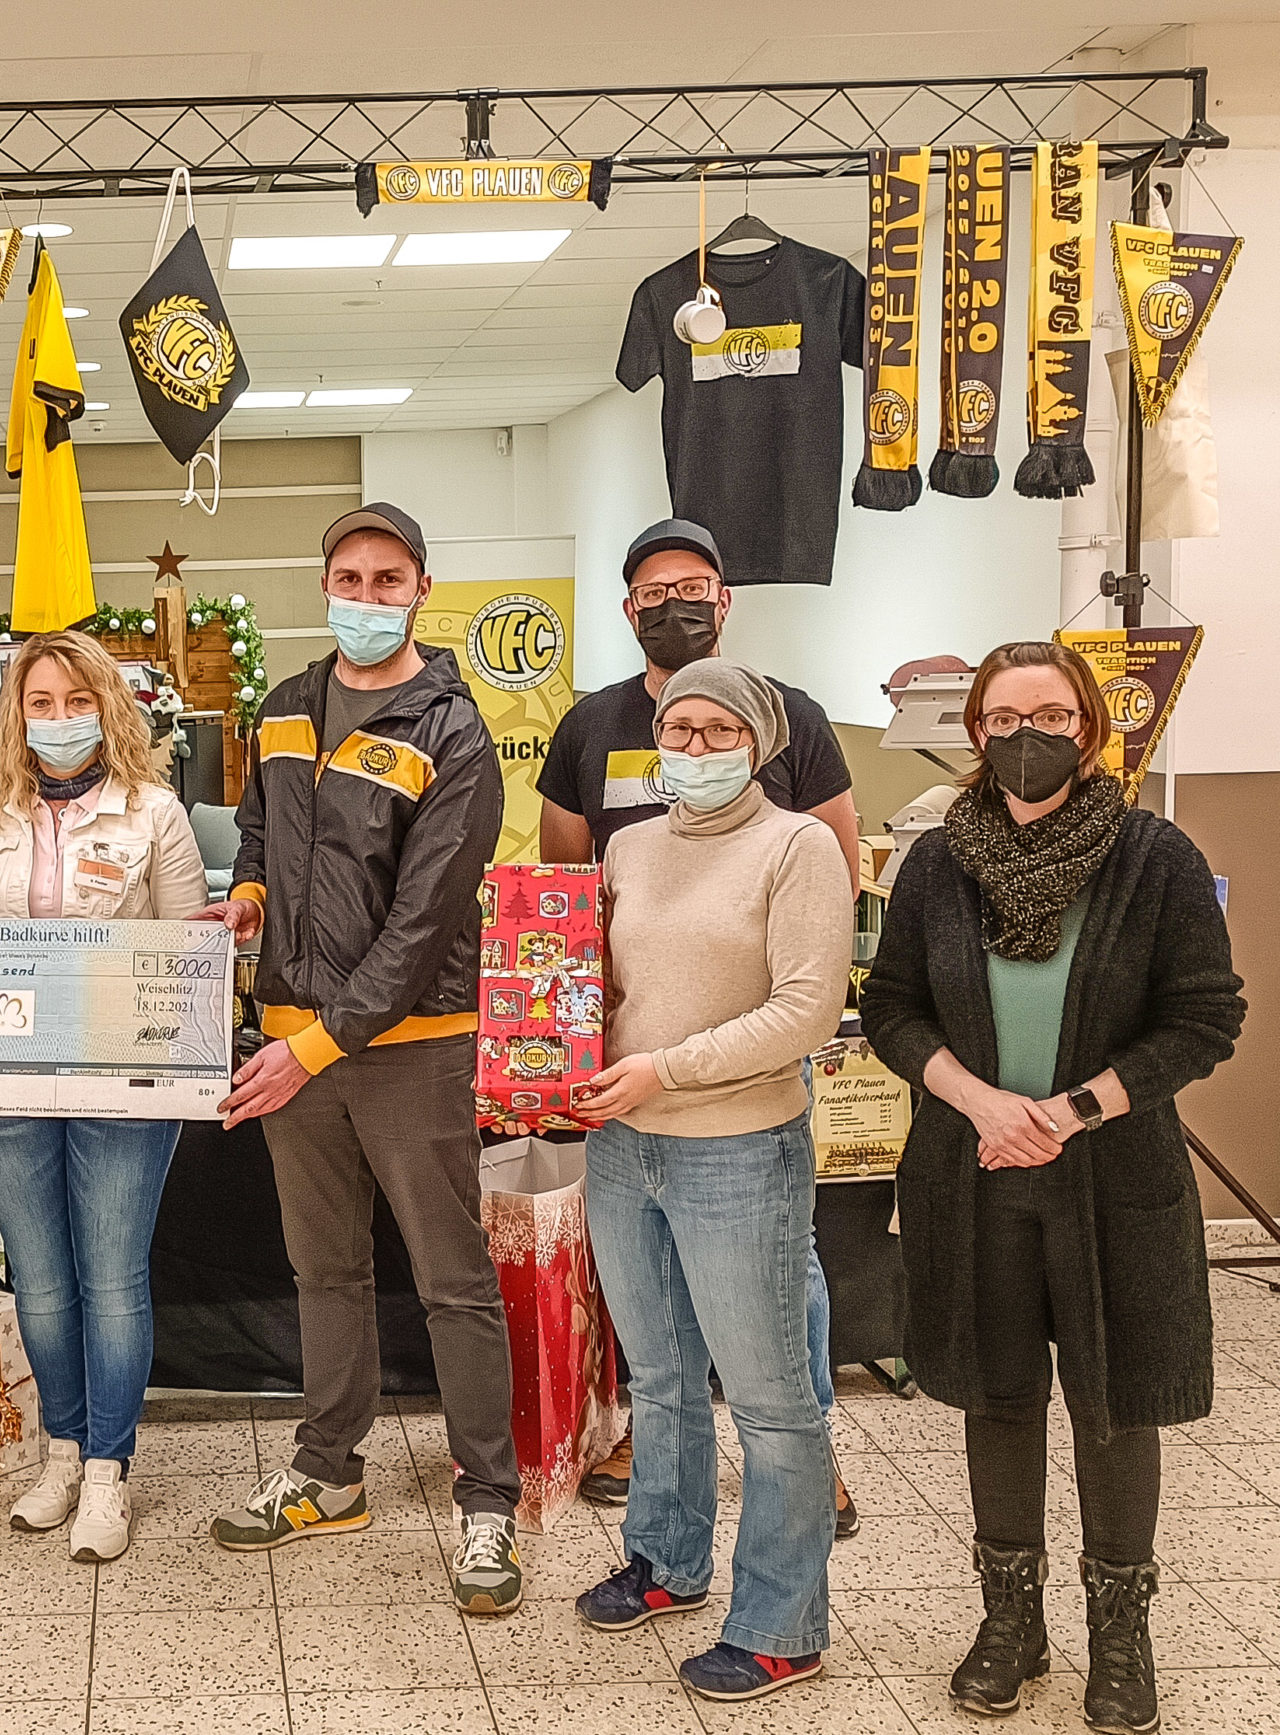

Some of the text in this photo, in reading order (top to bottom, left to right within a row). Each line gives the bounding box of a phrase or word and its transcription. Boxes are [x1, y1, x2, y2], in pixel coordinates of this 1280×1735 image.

[388, 172, 417, 194] VFC
[426, 167, 544, 197] VFC PLAUEN
[552, 170, 582, 193] VFC
[968, 144, 1004, 354] UEN 2.0
[1126, 238, 1222, 260] VFC PLAUEN
[1048, 234, 1084, 335] VFC
[1148, 291, 1189, 330] VFC
[161, 317, 216, 380] VFC
[728, 335, 767, 368] VFC
[134, 340, 201, 406] VFC PLAUEN
[479, 610, 556, 674] VFC
[1073, 641, 1182, 653] VFC PLAUEN
[1096, 656, 1157, 665] TRADITION
[495, 680, 537, 690] PLAUEN
[494, 735, 551, 761] rück
[0, 927, 110, 942] Badkurve hilft!
[141, 959, 149, 970] €
[137, 982, 193, 995] Weischlitz
[137, 1001, 193, 1012] 18.12.2021
[156, 1079, 175, 1087] EUR
[832, 1078, 886, 1090] VFC Plauen
[818, 1089, 901, 1105] Fanartikelverkauf
